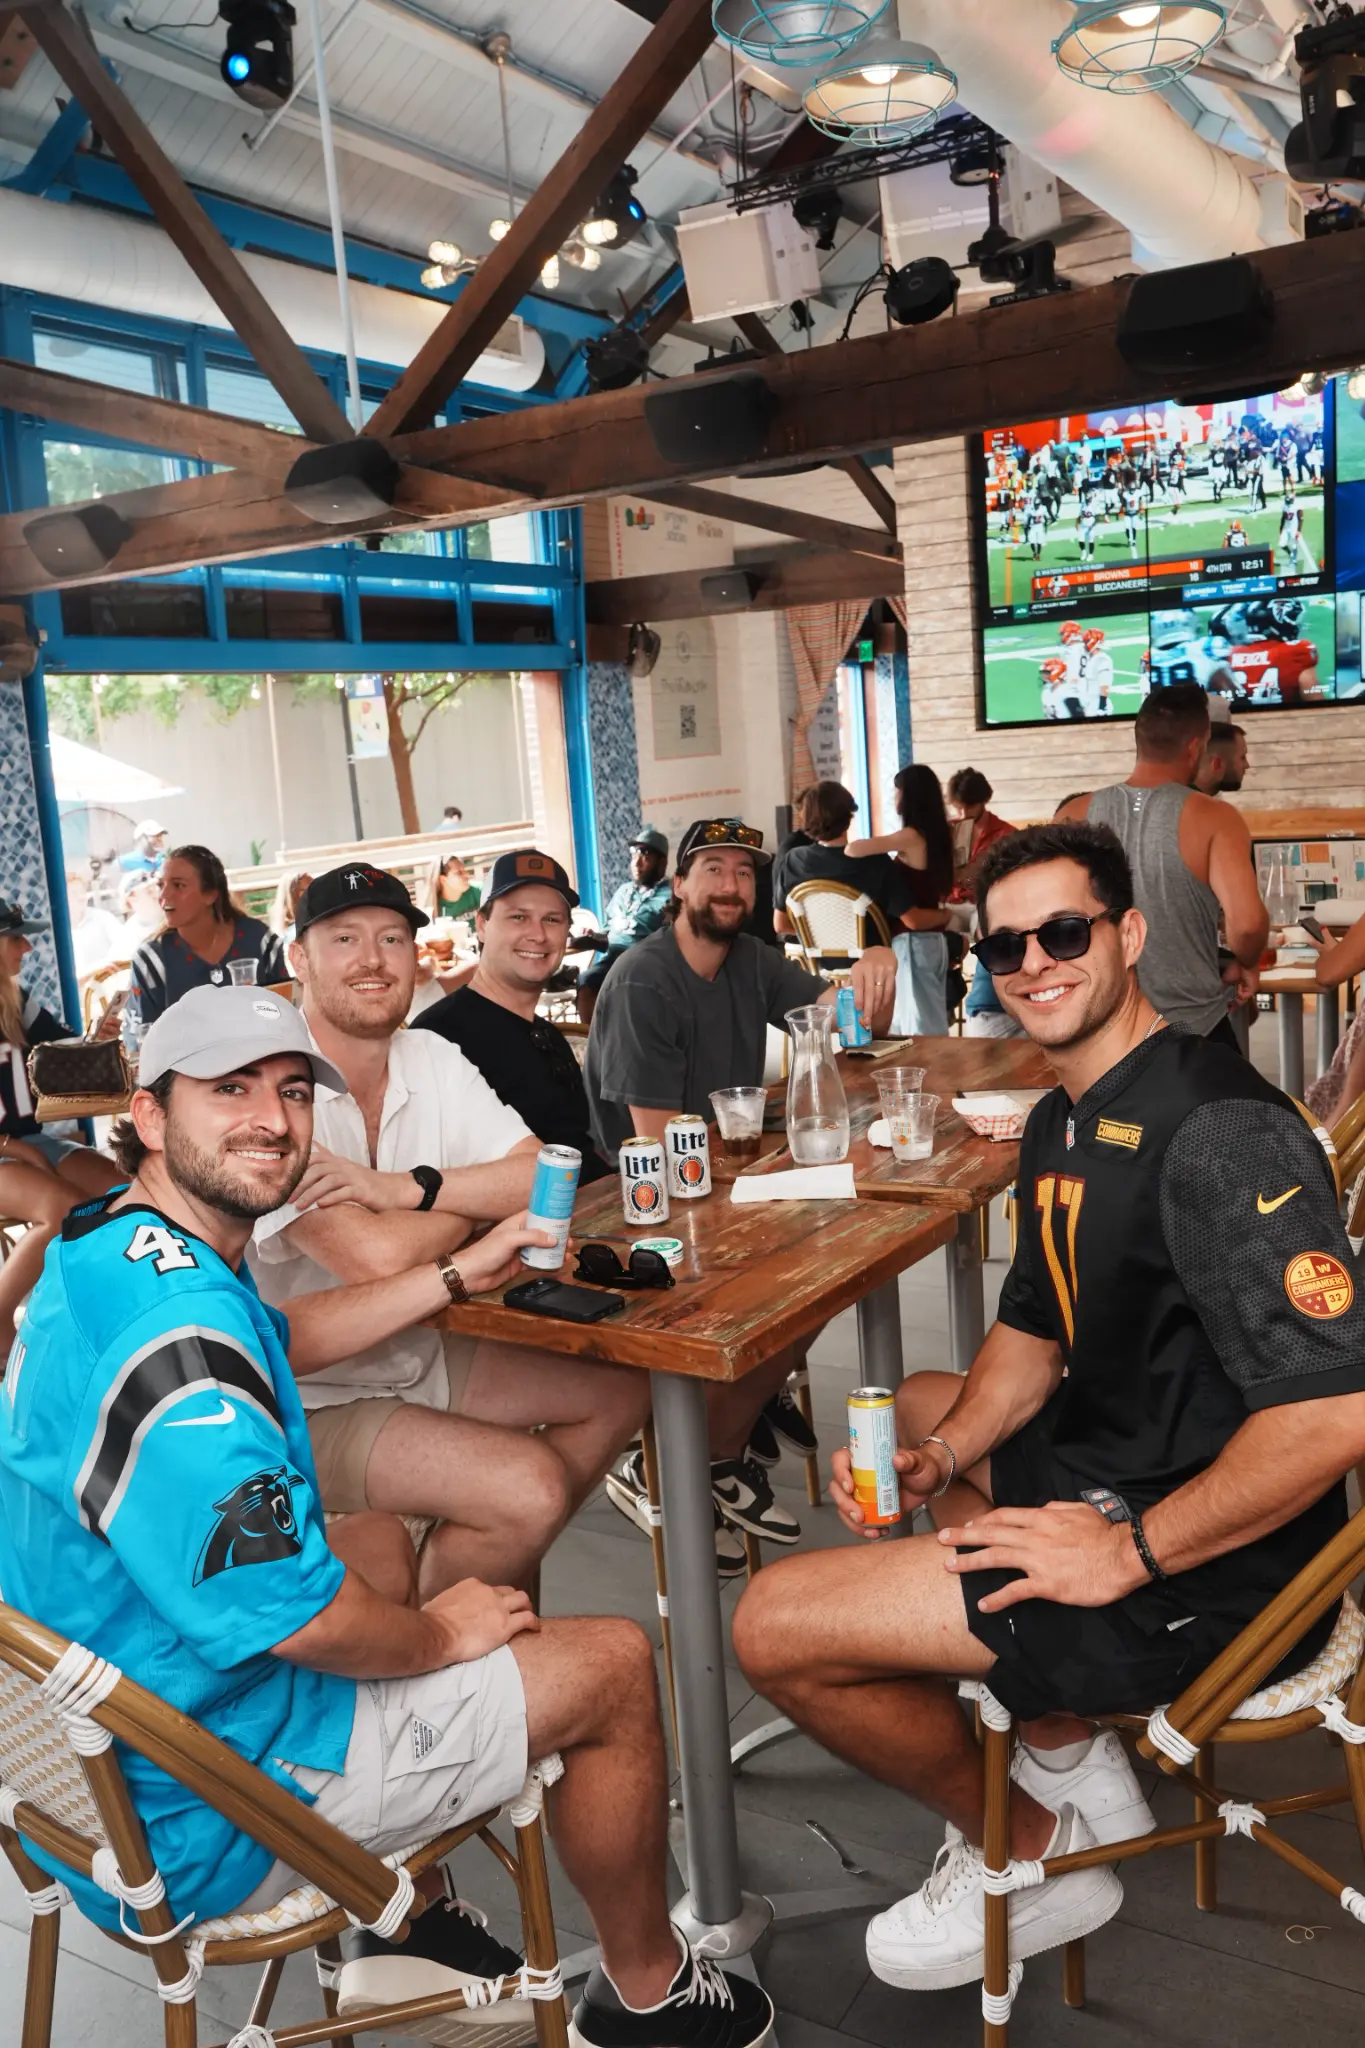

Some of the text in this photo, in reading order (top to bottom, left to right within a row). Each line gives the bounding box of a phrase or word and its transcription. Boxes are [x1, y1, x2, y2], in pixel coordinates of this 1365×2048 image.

[1206, 563, 1232, 574] 4TH QTR
[1241, 559, 1264, 571] 12:51
[1093, 569, 1130, 581] BROWNS
[1093, 578, 1149, 592] BUCCANEERS
[1097, 1123, 1142, 1146] COMMANDERS
[672, 1132, 706, 1155] Lite
[624, 1155, 660, 1180] Lite
[123, 1224, 199, 1277] 4
[1034, 1172, 1085, 1348] 17
[1297, 1268, 1311, 1277] 19
[1315, 1263, 1331, 1273] W
[1292, 1275, 1346, 1296] COMMANDERS
[1329, 1293, 1342, 1303] 32
